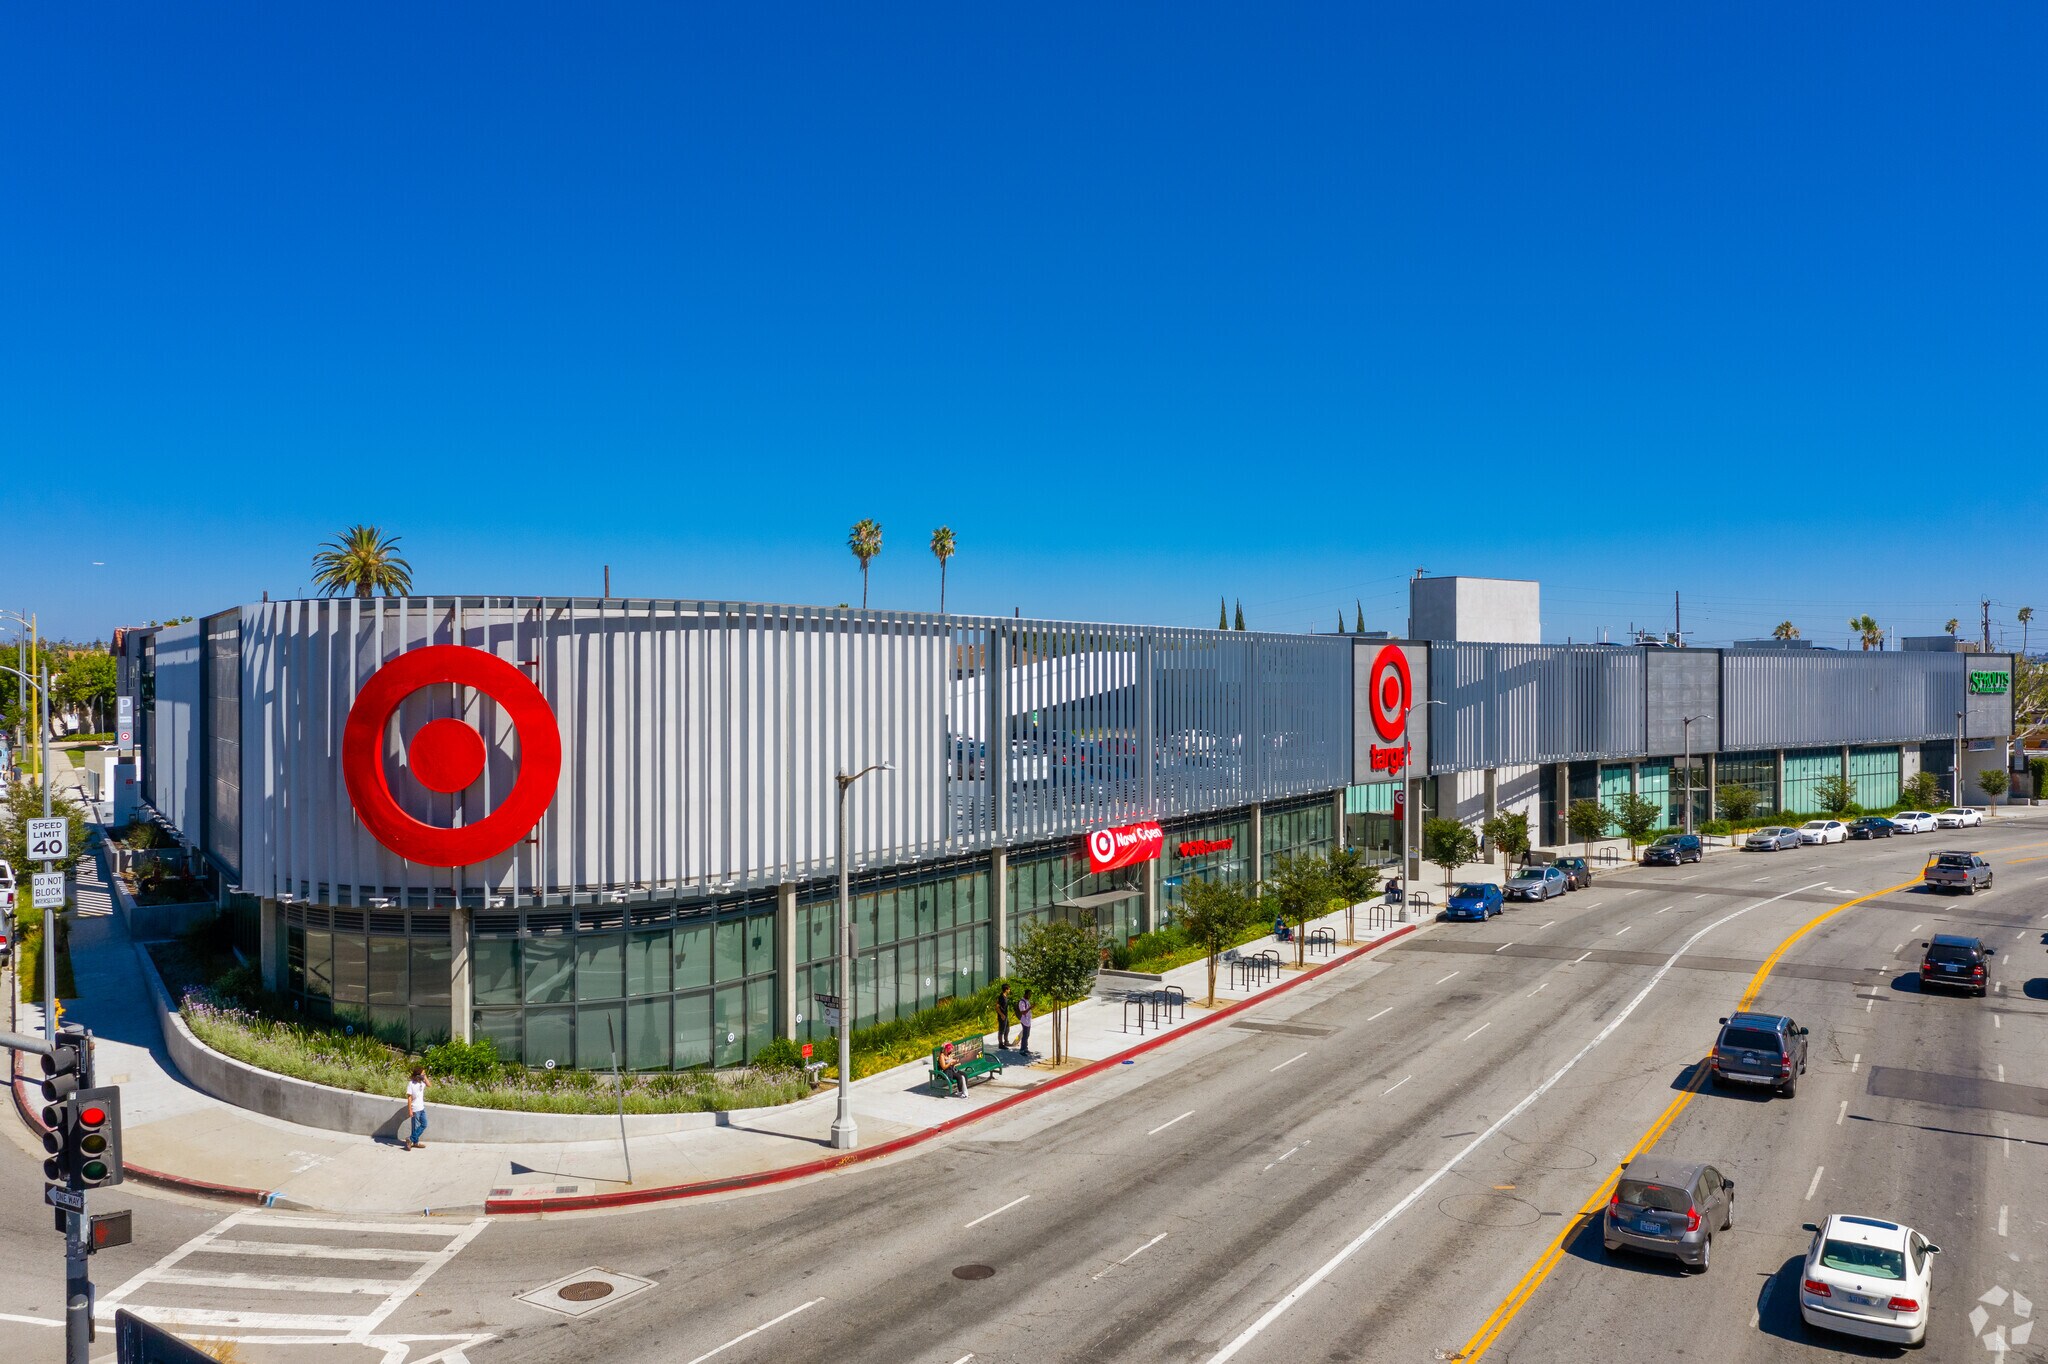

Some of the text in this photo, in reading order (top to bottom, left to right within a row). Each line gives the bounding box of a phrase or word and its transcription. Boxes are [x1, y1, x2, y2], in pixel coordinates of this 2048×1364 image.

[1970, 670, 2009, 692] SPROUTS
[120, 698, 131, 714] P
[32, 822, 62, 830] SPEED
[1115, 832, 1137, 847] Now
[32, 840, 63, 855] 40
[34, 877, 62, 886] DO NOT
[35, 888, 62, 897] BLOCK
[56, 1191, 80, 1206] ONE WAY
